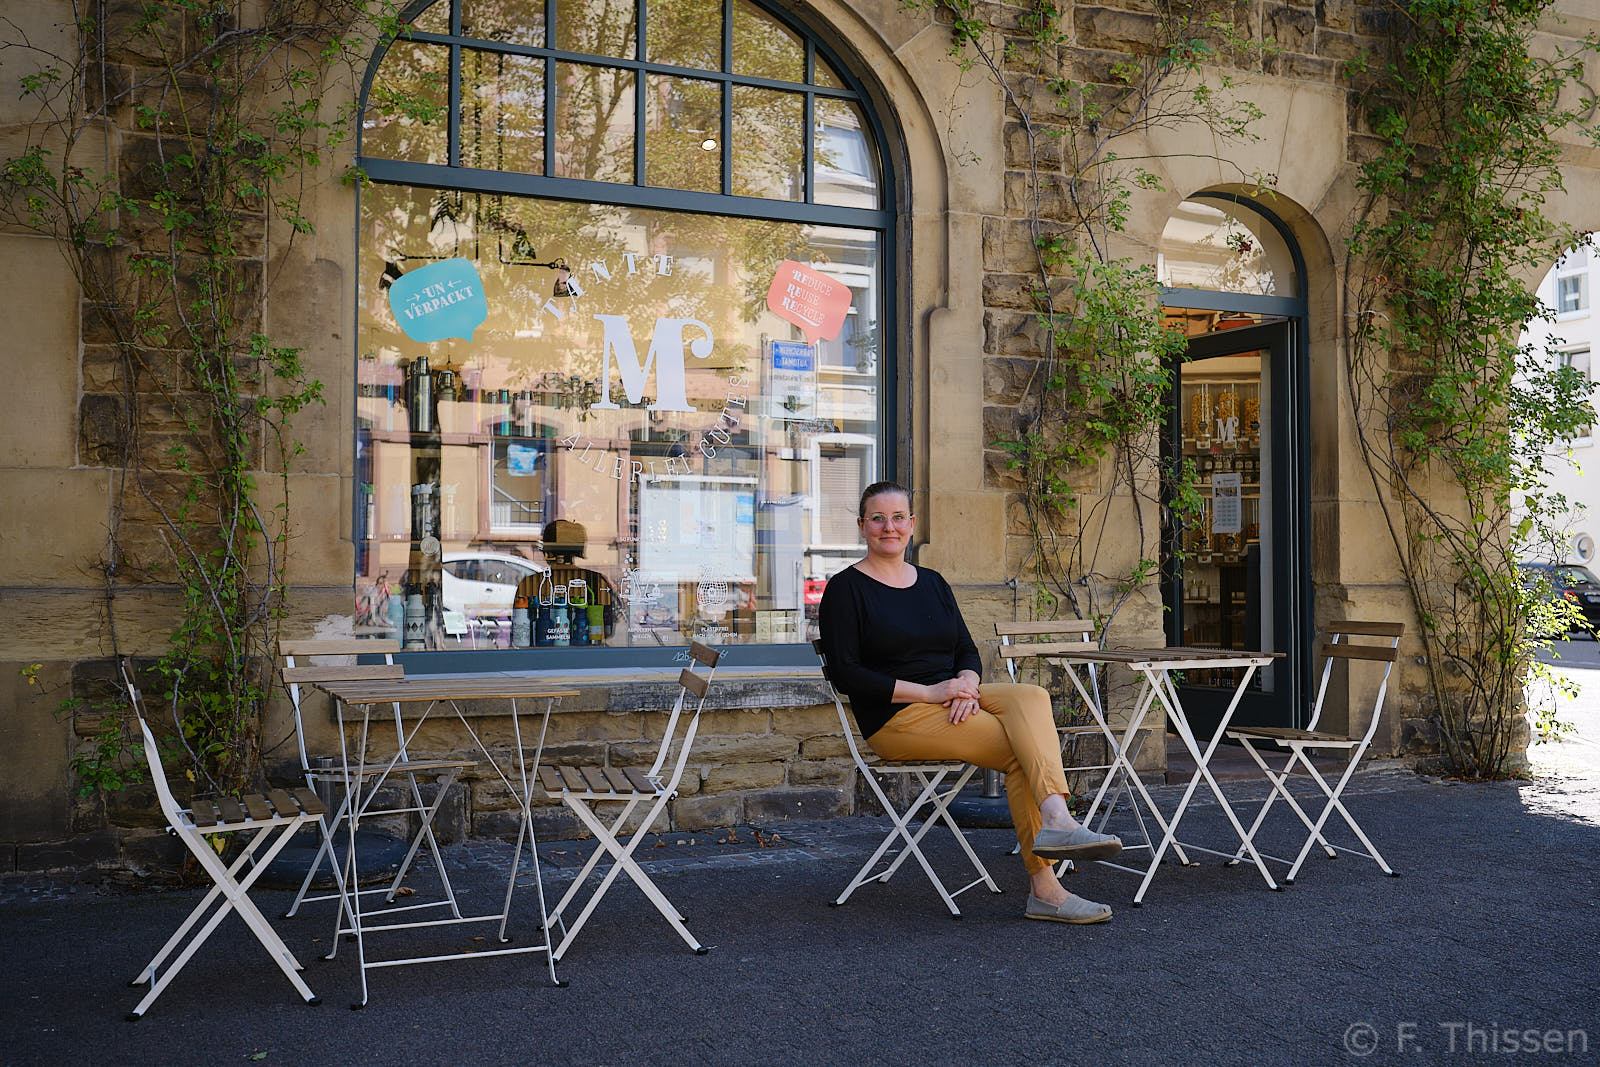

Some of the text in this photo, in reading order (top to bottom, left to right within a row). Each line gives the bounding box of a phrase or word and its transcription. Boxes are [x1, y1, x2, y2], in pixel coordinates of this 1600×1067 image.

[422, 282, 446, 298] UN
[542, 252, 673, 320] TANTE
[786, 283, 820, 306] REUSE
[792, 269, 833, 297] REDUCE
[403, 285, 474, 320] VERPACKT
[782, 296, 825, 325] RECYCLE
[590, 313, 714, 412] M
[560, 375, 750, 484] ALLERLEI GUTES
